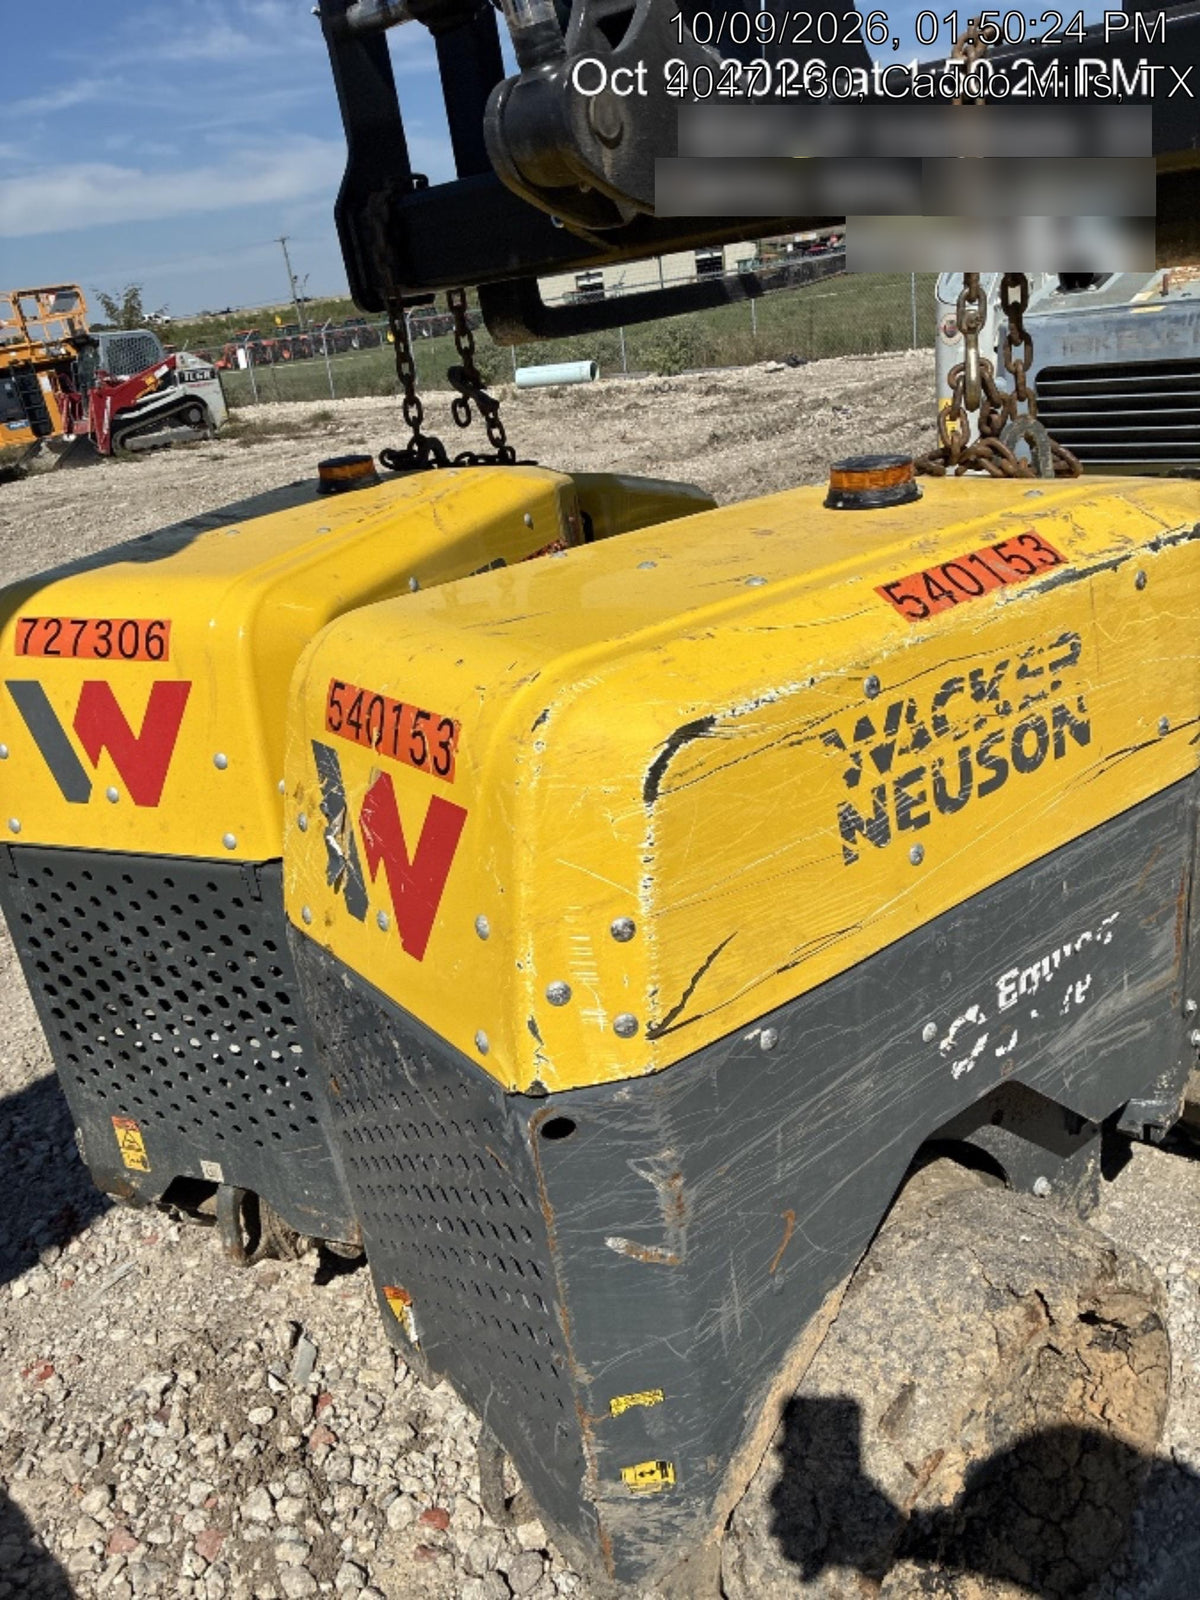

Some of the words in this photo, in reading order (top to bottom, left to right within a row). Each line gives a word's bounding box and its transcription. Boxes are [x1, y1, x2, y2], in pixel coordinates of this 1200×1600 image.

[881, 533, 1062, 620] 540153
[20, 617, 166, 660] 727306
[326, 680, 457, 777] 540153
[836, 694, 1092, 866] NEUSON
